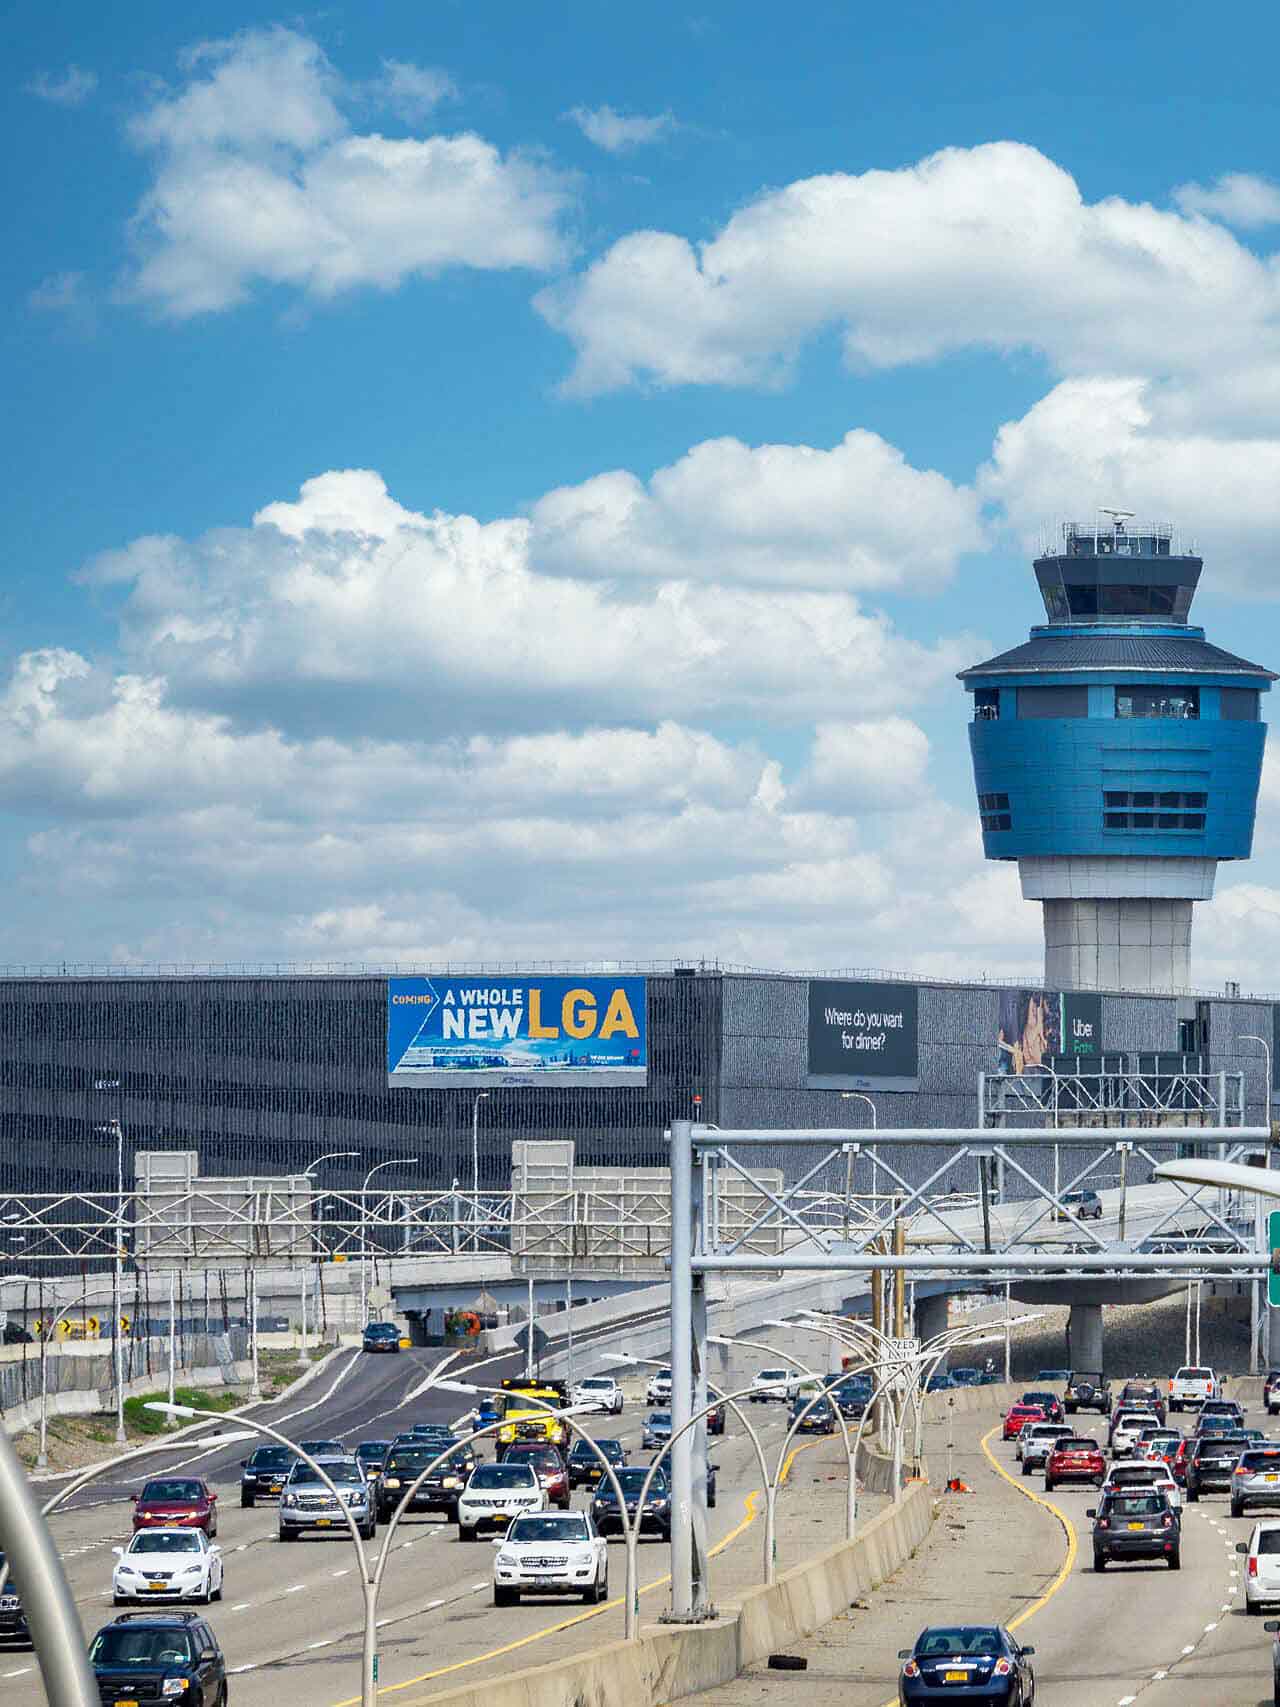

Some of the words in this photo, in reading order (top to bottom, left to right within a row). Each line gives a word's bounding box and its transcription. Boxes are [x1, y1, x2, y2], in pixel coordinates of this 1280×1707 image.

[443, 990, 455, 1005] A
[460, 989, 523, 1005] WHOLE
[442, 1008, 523, 1039] NEW
[528, 989, 639, 1039] LGA
[824, 1008, 852, 1026] Where
[853, 1008, 865, 1026] do
[866, 1012, 882, 1031] you
[883, 1012, 903, 1028] want
[1073, 1018, 1093, 1037] Uber
[842, 1031, 854, 1049] for
[855, 1032, 886, 1050] dinner?
